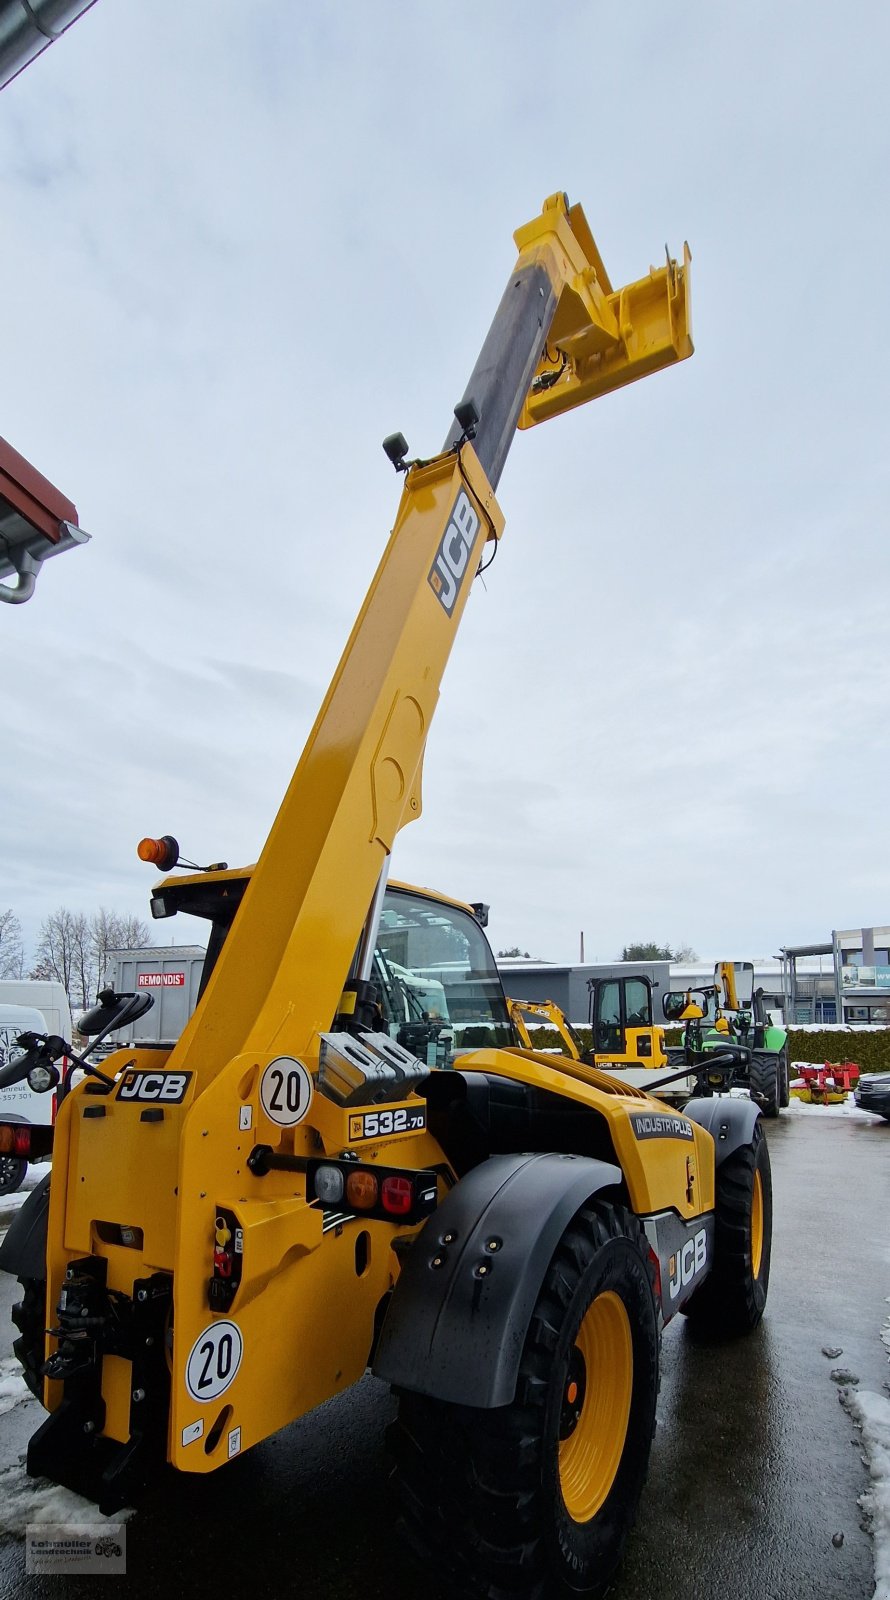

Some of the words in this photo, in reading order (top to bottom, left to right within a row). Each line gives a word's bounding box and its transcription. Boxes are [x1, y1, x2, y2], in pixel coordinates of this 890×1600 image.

[436, 492, 478, 608] JCB
[120, 1074, 187, 1099] JCB
[269, 1069, 301, 1112] 20
[669, 1228, 707, 1299] JCB
[197, 1333, 233, 1391] 20
